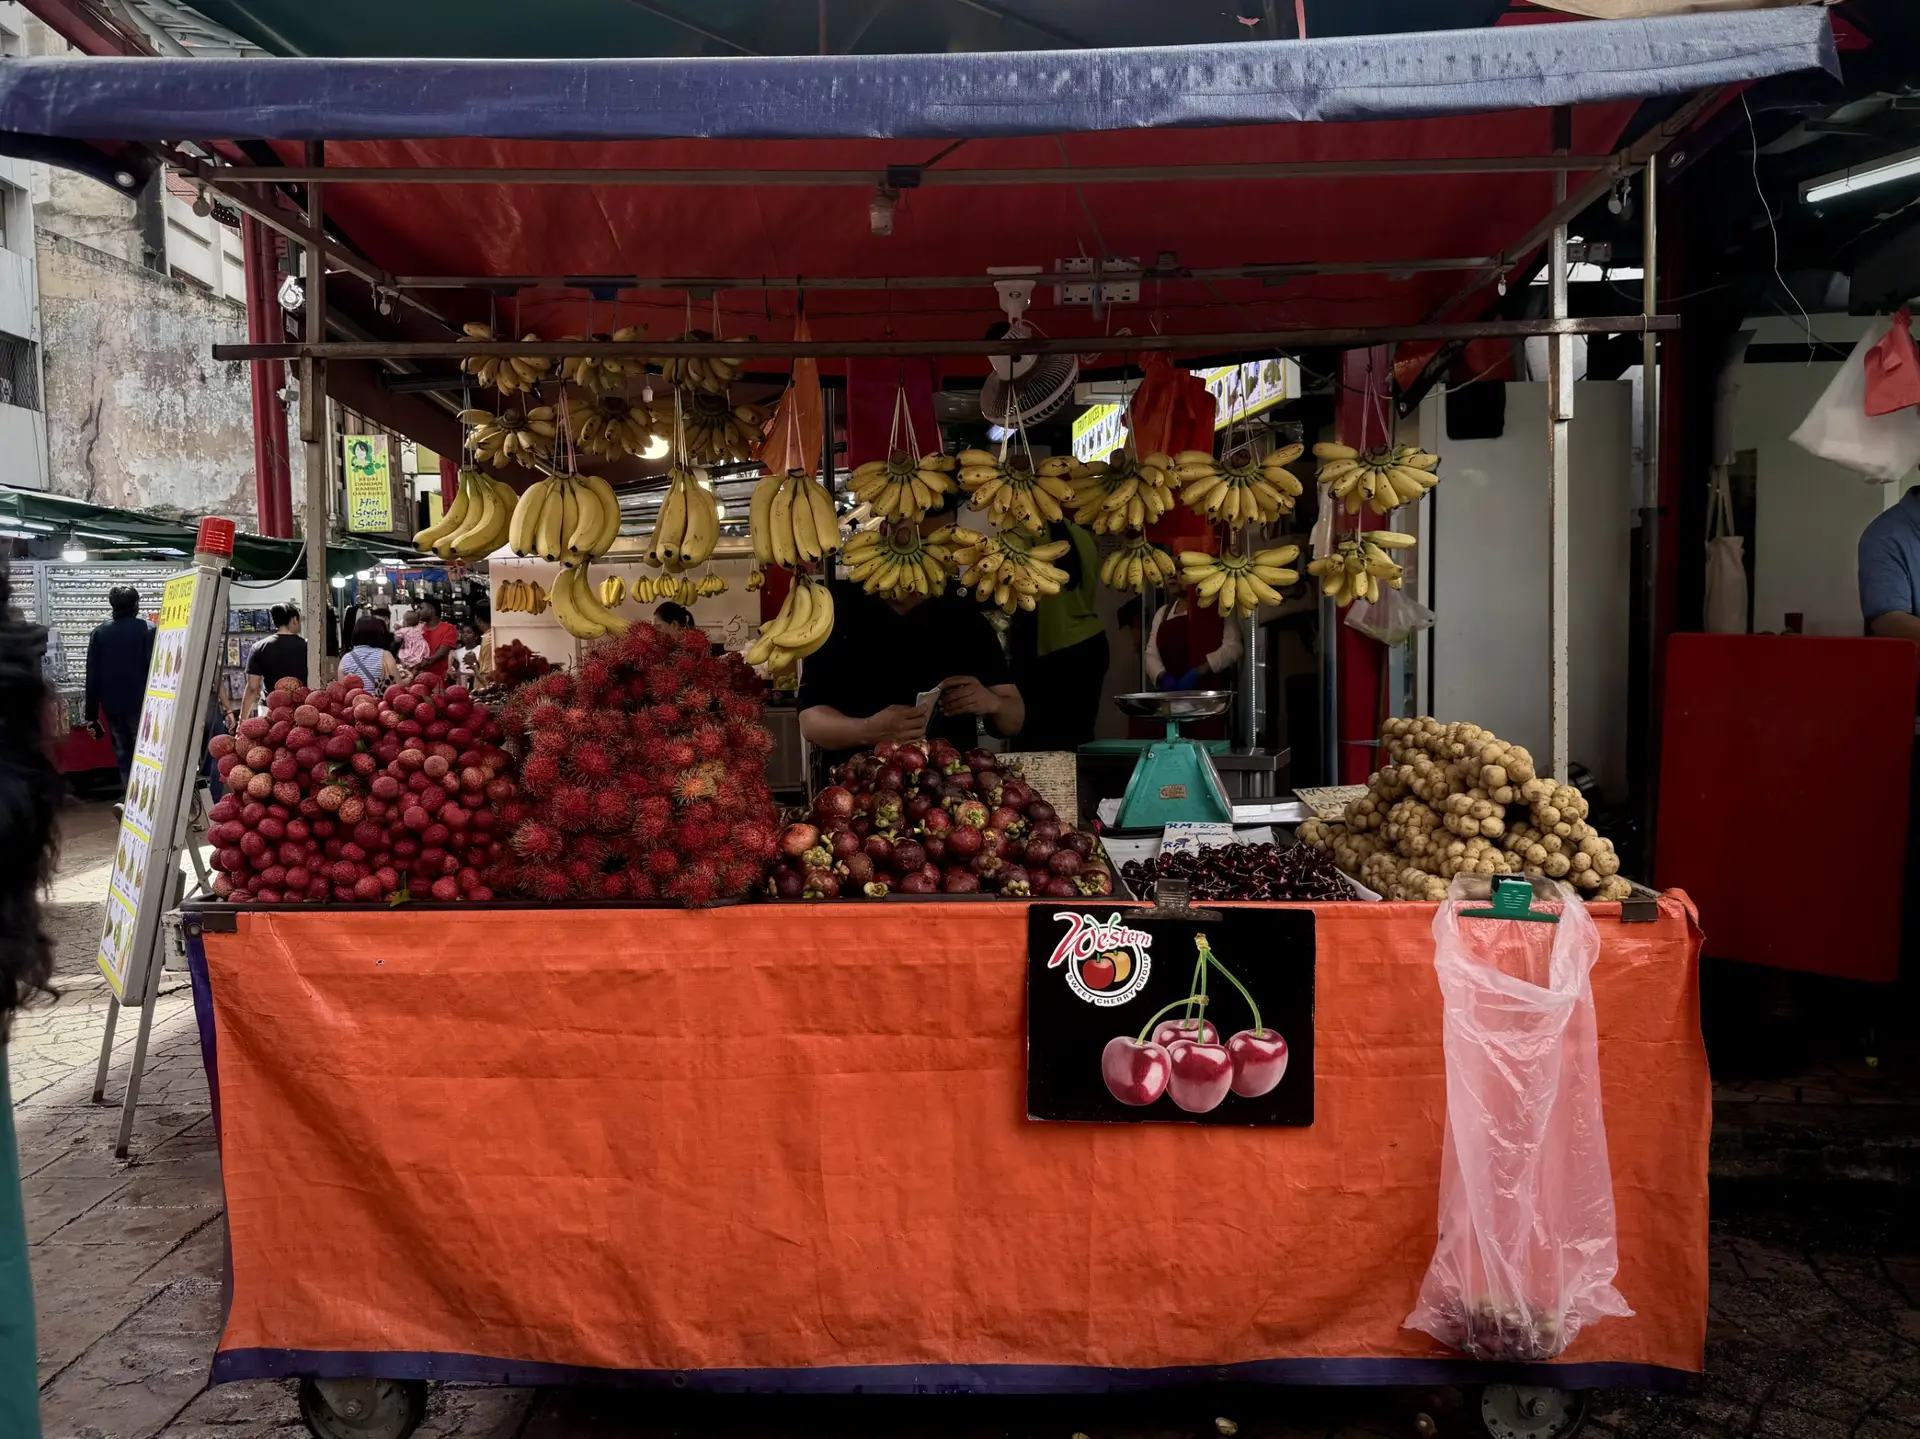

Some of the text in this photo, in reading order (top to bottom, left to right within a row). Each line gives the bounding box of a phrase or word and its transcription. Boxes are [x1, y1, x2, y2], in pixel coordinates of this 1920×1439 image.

[352, 508, 388, 519] Styling
[354, 519, 387, 529] Saloon
[168, 580, 194, 600] FRUIT JUICES
[1048, 913, 1151, 967] Western
[1067, 955, 1150, 1005] SWEET CHERRY GROUP
